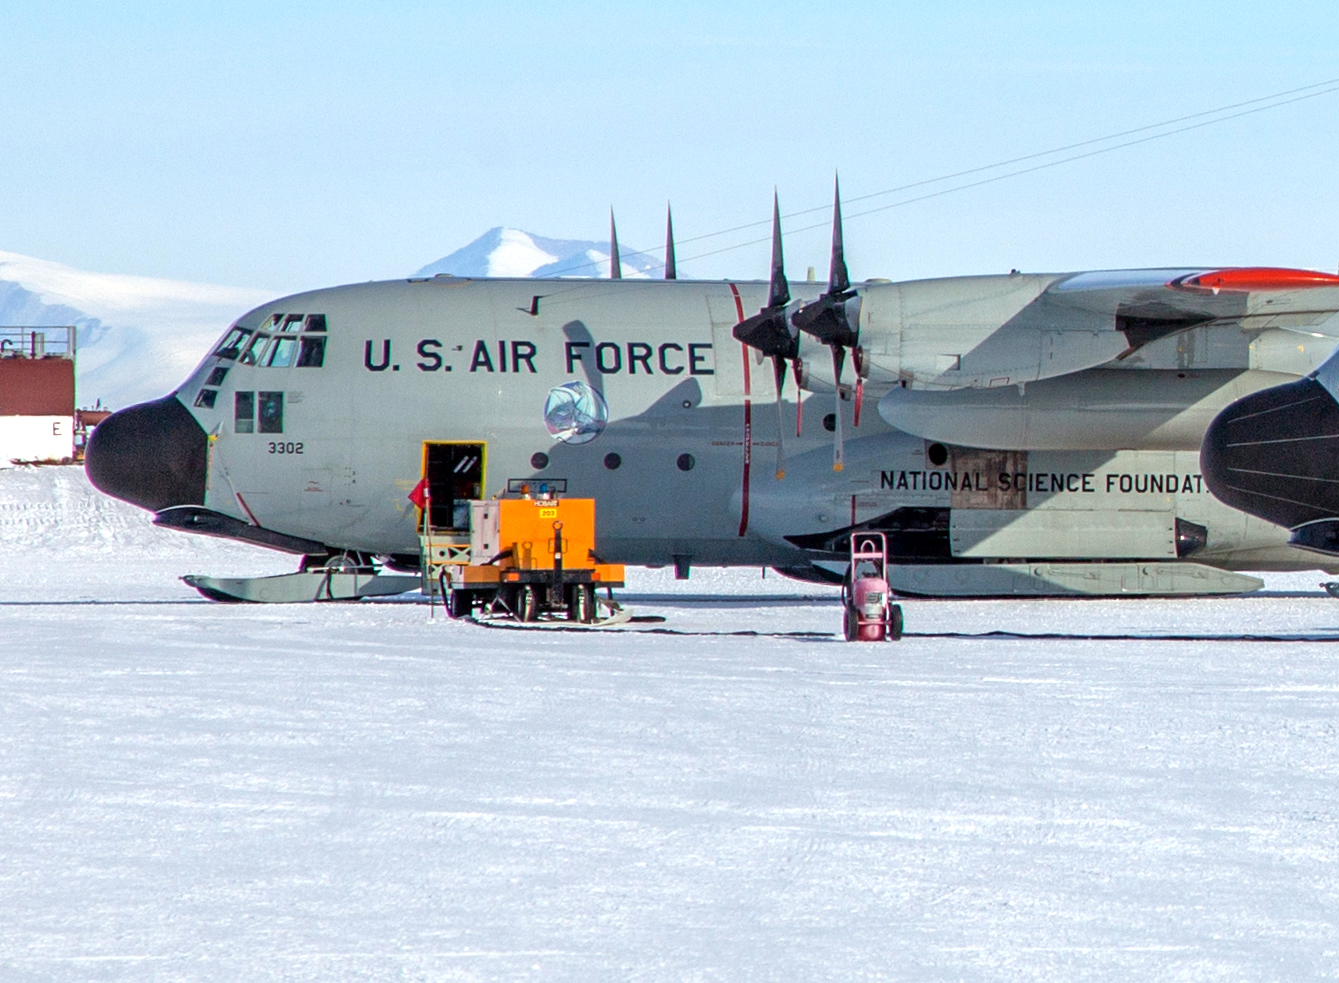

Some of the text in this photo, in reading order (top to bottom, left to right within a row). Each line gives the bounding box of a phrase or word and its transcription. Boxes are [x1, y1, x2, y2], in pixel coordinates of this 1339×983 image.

[364, 339, 715, 375] U. S. AIR FORCE
[268, 442, 304, 454] 3302
[880, 470, 1210, 494] NATIONAL SCIENCE FOUNDAT
